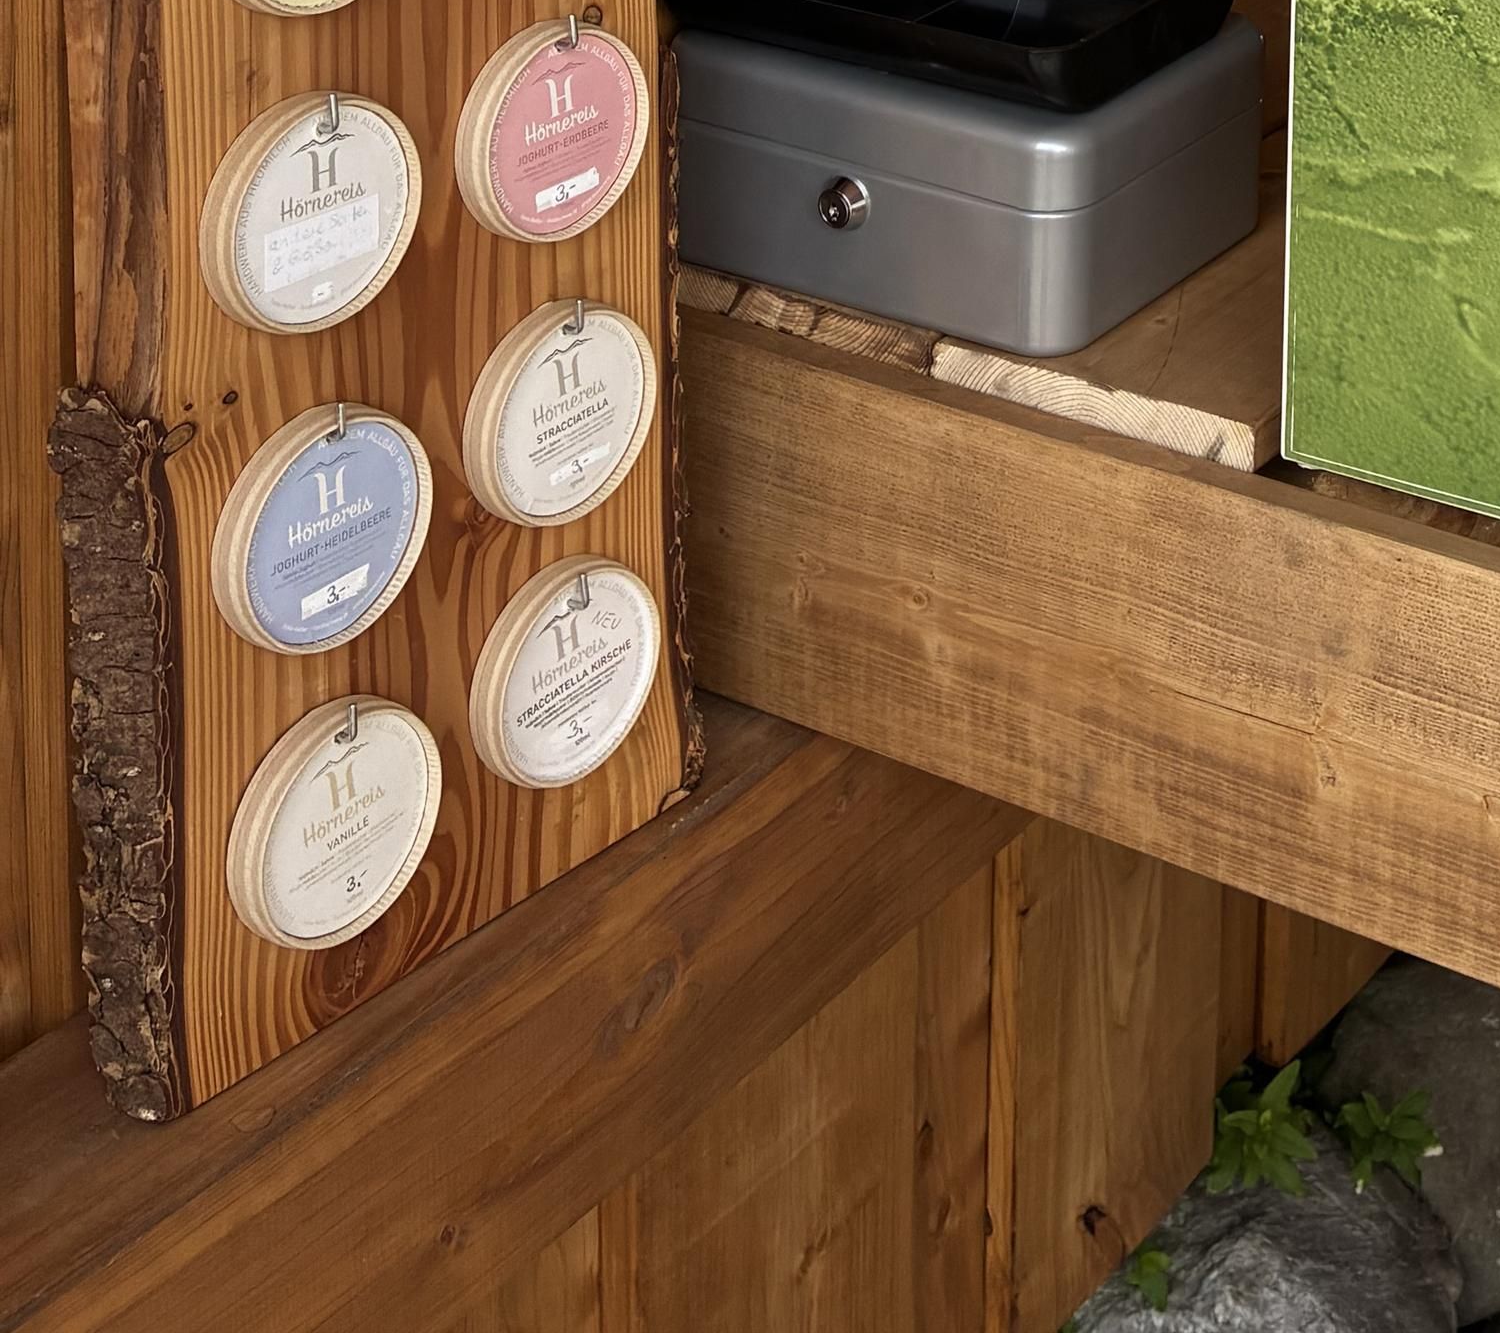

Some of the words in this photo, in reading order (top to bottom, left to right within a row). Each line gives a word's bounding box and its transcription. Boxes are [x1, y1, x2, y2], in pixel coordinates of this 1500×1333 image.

[516, 119, 609, 168] JOGHURT-ERDBEERE
[525, 103, 599, 147] Hörnereis
[280, 181, 367, 223] Hörnereis
[555, 183, 576, 202] 3,-
[532, 379, 607, 429] Hörnereis
[536, 397, 609, 445] STRACCIATELLA
[270, 506, 392, 577] JOGHURT-HEIDELBEERE
[287, 495, 374, 549] Hörnereis
[326, 584, 347, 605] 3,-
[591, 610, 623, 631] NEU
[516, 668, 590, 727] STRACCIATELLA
[590, 638, 633, 674] KIRSCHE
[531, 635, 609, 695] Hörnereis
[303, 782, 387, 848] Hörnereis
[325, 814, 370, 852] VANILLE
